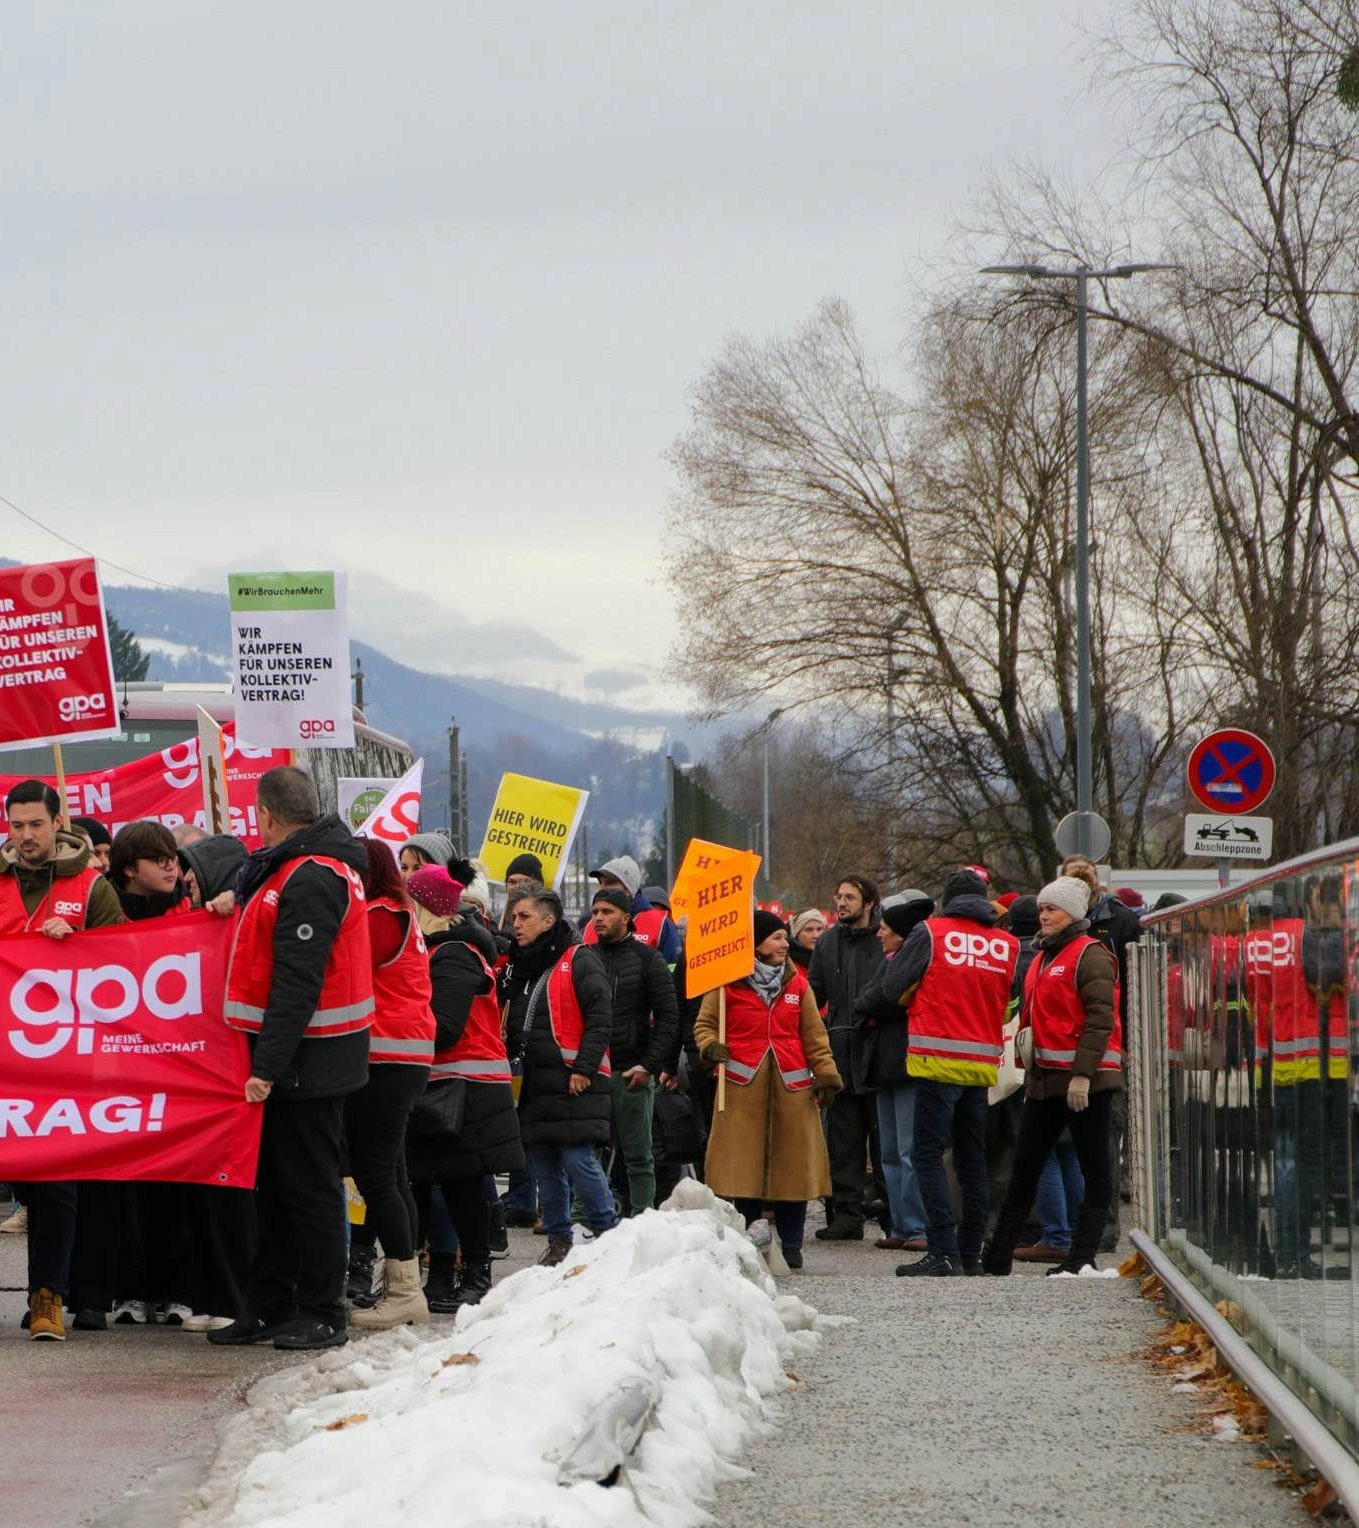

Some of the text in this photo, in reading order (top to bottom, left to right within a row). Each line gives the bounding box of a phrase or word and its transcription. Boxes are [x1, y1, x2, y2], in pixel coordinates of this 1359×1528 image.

[237, 586, 323, 597] #WirBrauchenMehr
[23, 624, 98, 647] UNSEREN
[238, 627, 262, 639] WIR
[238, 639, 303, 655] KÄMPFEN
[239, 655, 332, 671] FÜR UNSEREN
[240, 673, 318, 686] KOLLEKTIV-
[241, 689, 305, 702] VERTRAG!
[58, 692, 106, 722] gpa
[299, 720, 335, 739] gpa
[494, 808, 567, 837] HIER WIRD
[487, 828, 562, 859] GESTREIKT!
[1194, 841, 1262, 855] Abschleppzone
[697, 874, 744, 908] HIER
[54, 901, 82, 915] gpa
[699, 910, 739, 937] WIRD
[689, 931, 750, 970] GESTREIKT!
[944, 931, 1009, 967] gpa
[7, 951, 203, 1059] gpa
[101, 1040, 206, 1055] GEWERKSCHAFT
[102, 1033, 144, 1045] MEINE
